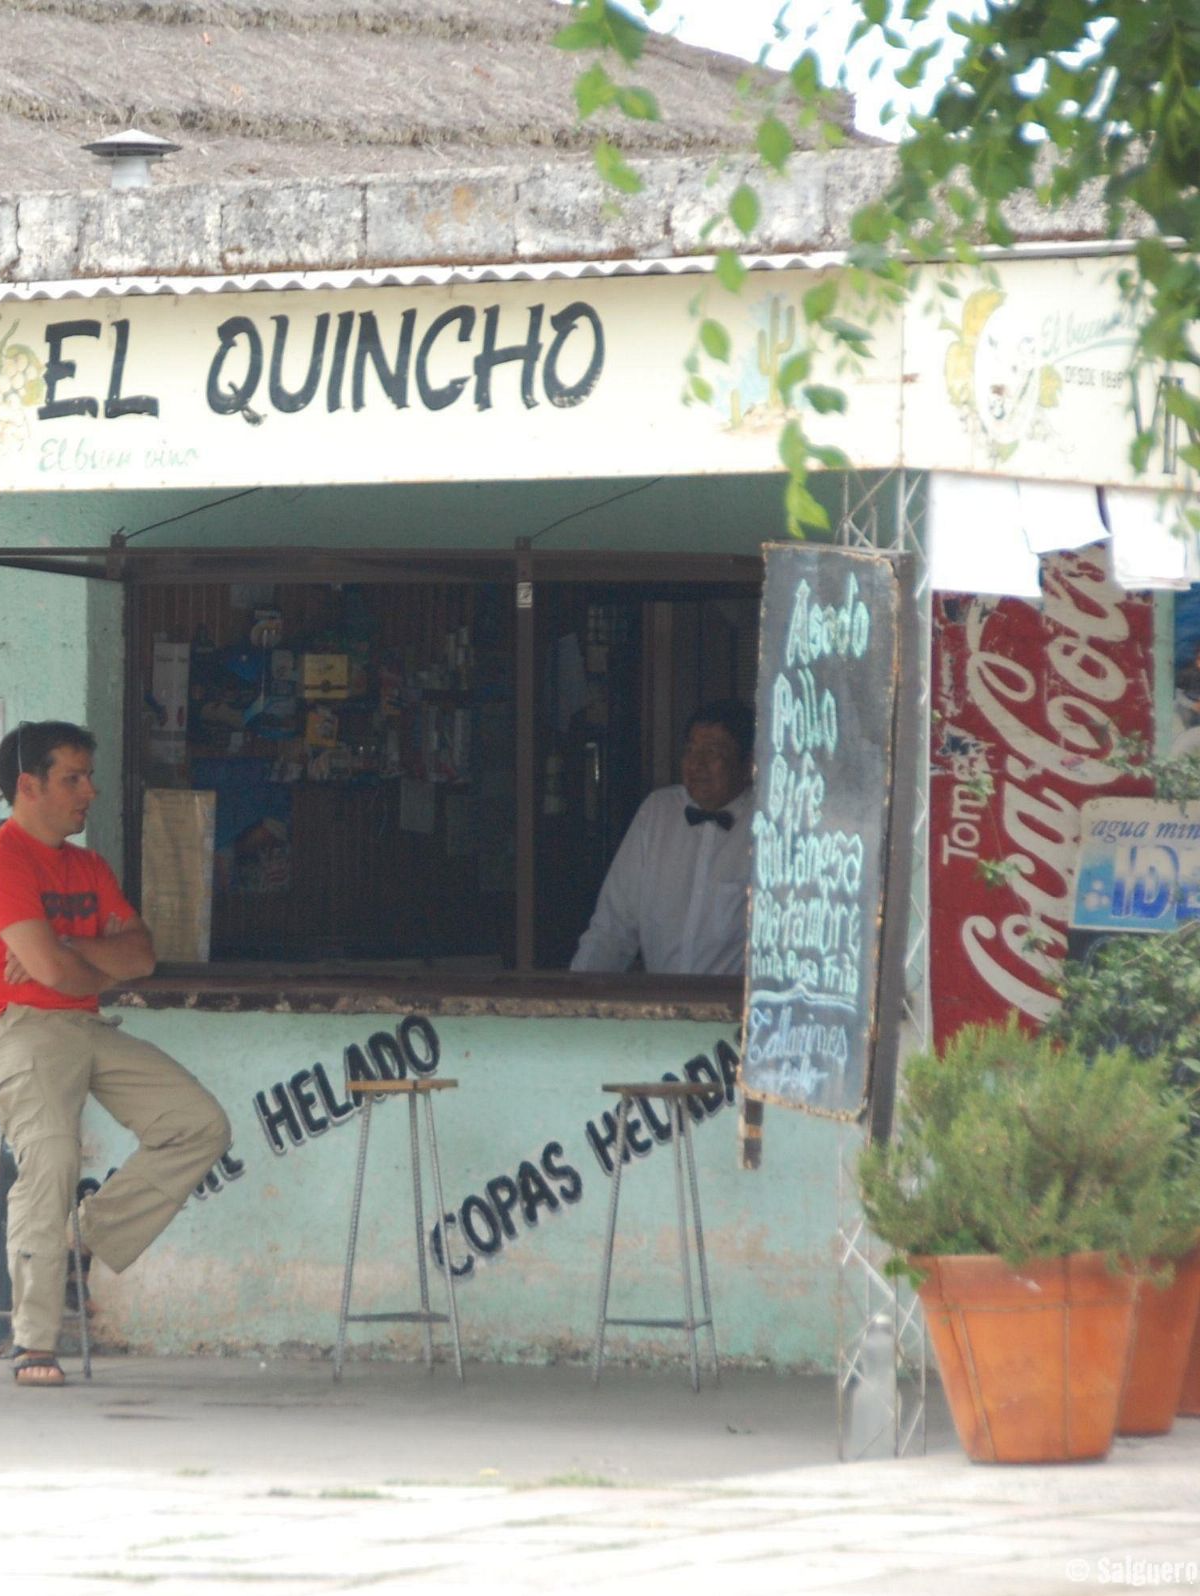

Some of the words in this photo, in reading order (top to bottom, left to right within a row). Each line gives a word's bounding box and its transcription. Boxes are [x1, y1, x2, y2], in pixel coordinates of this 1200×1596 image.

[38, 319, 160, 420] EL
[205, 300, 606, 427] QUINCHO
[771, 665, 837, 760] Pollo
[1090, 820, 1150, 843] agua
[254, 1014, 441, 1154] HELADO
[584, 1026, 743, 1177] HELADA
[430, 1140, 585, 1278] COPAS
